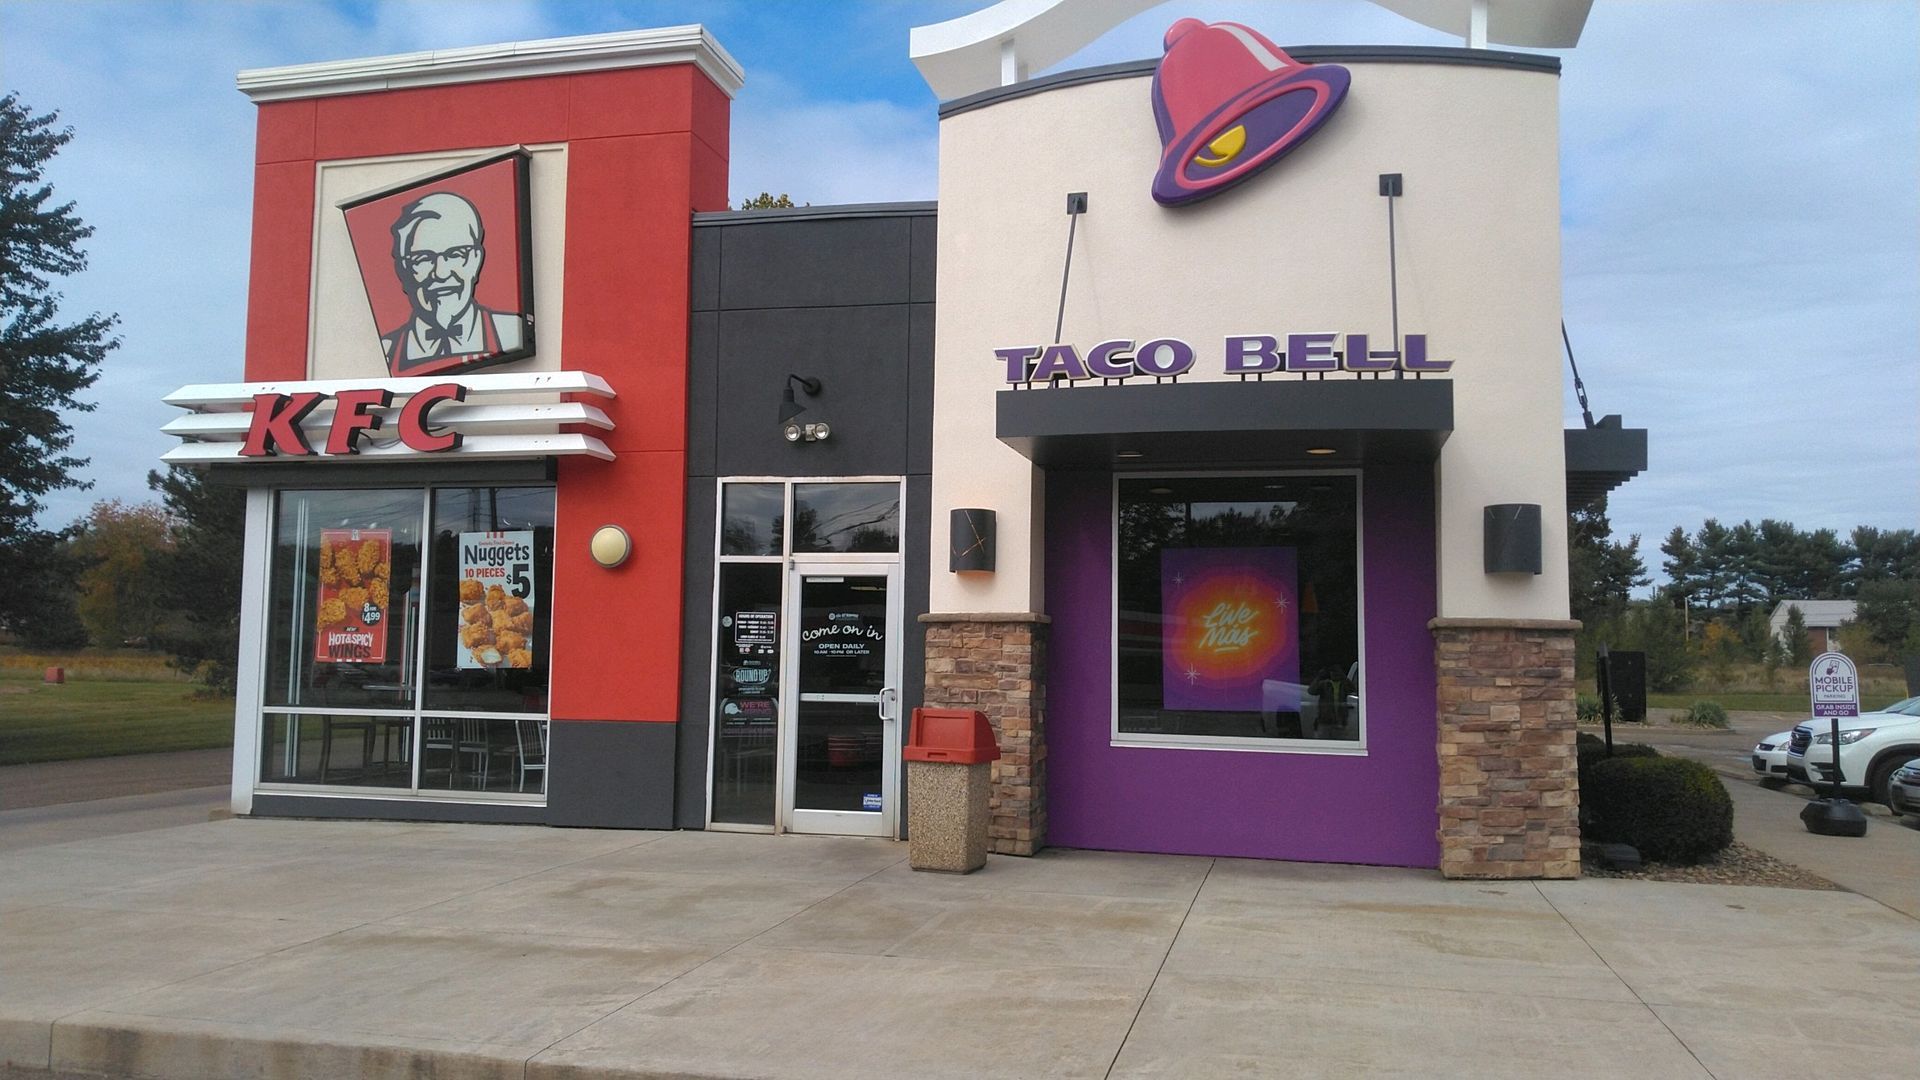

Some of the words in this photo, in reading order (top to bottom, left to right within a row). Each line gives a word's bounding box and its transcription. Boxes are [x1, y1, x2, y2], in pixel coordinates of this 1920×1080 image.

[993, 337, 1197, 384] TACO
[1223, 331, 1456, 374] BELL
[238, 382, 467, 457] KFC
[464, 542, 530, 567] Nuggets
[464, 568, 475, 578] 10
[476, 567, 506, 578] PIECES
[506, 564, 531, 599] $5
[1202, 601, 1259, 628] Live
[802, 624, 840, 641] come
[842, 624, 864, 636] on
[866, 625, 883, 640] in
[328, 644, 372, 659] WINGS
[735, 669, 758, 682] ROUND
[758, 669, 769, 682] UP
[1815, 676, 1853, 684] MOBILE
